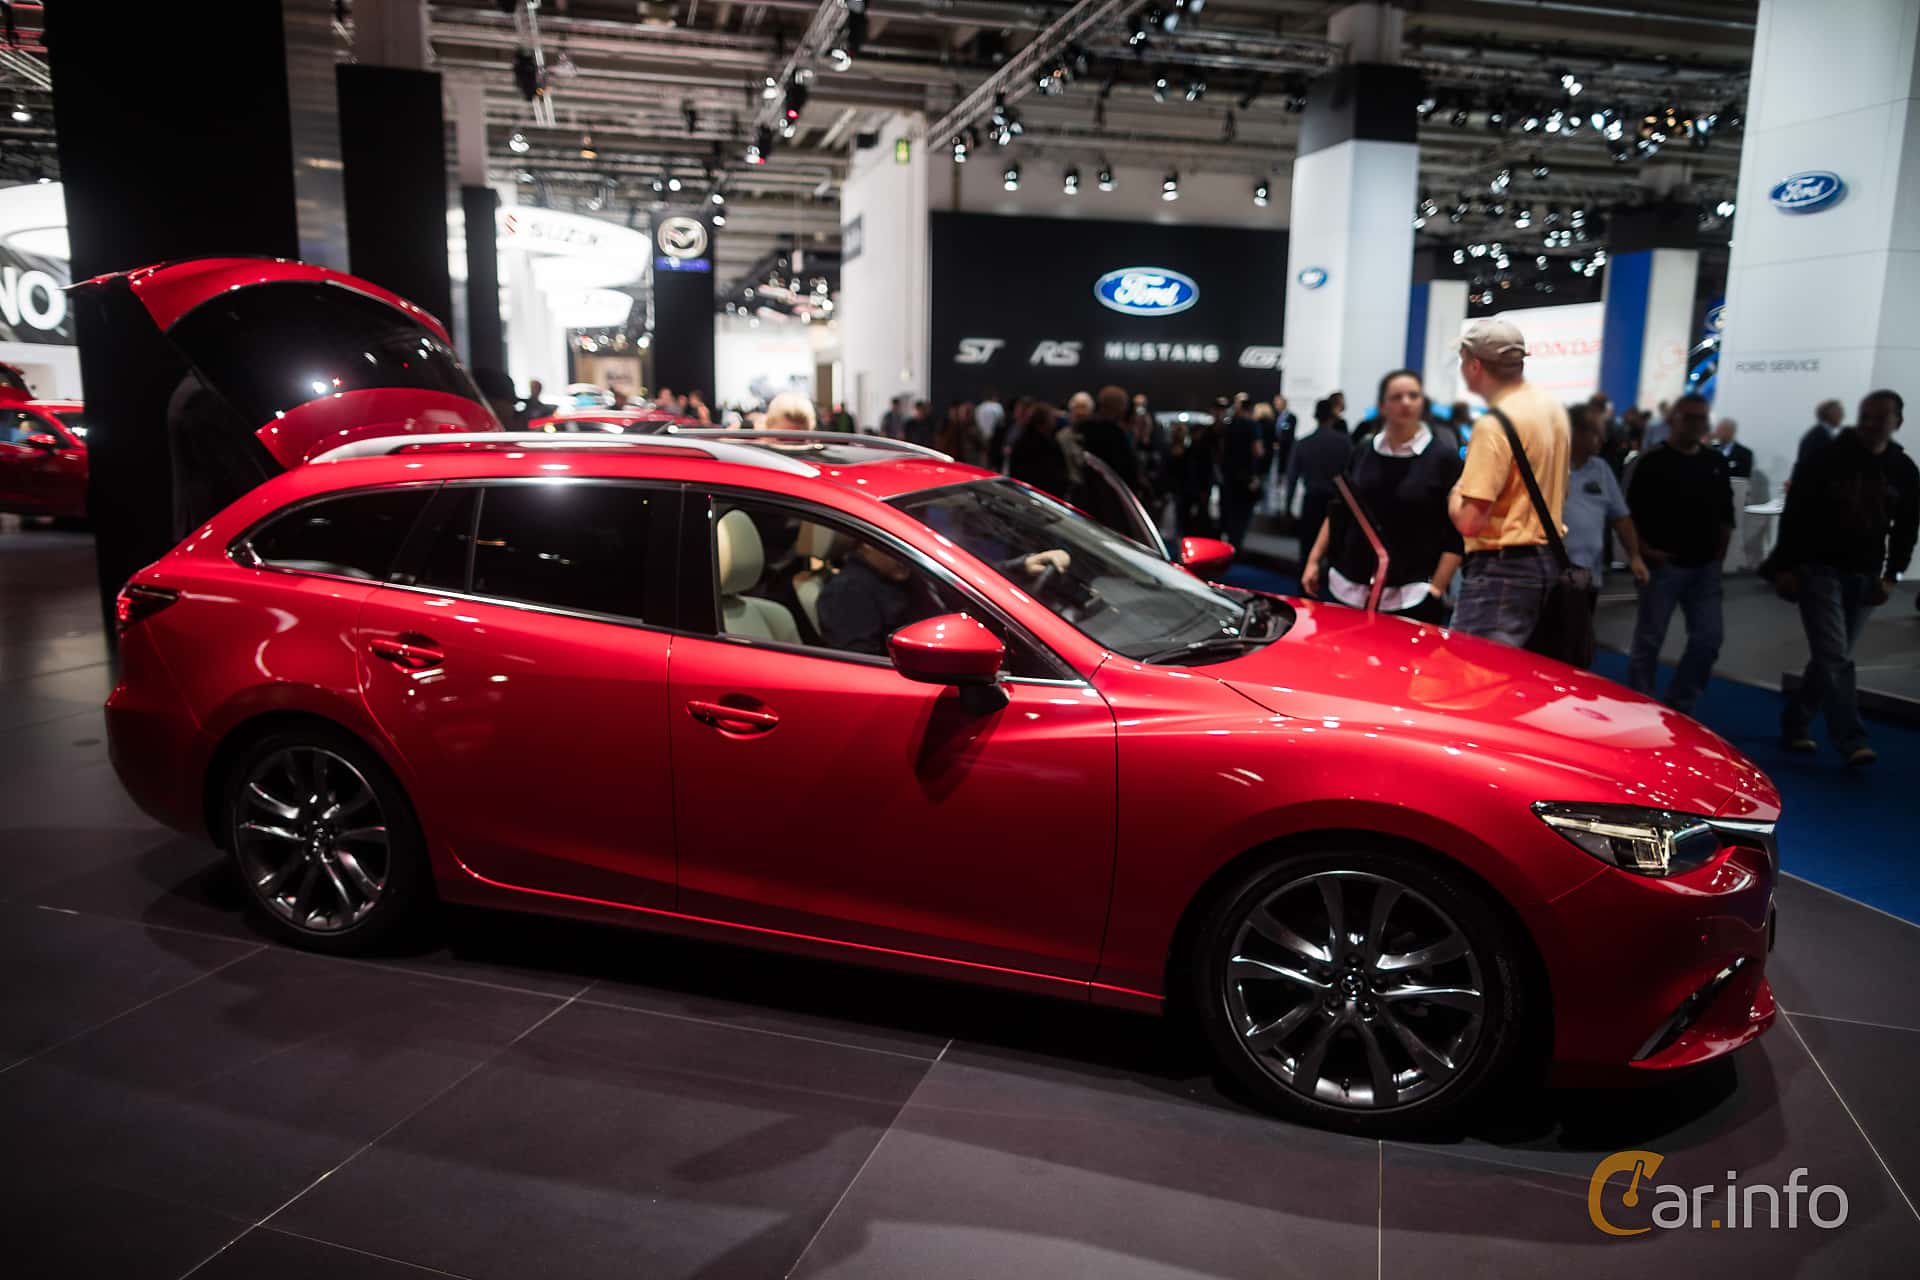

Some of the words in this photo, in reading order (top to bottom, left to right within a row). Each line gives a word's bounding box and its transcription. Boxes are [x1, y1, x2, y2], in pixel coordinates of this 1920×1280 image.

[1780, 177, 1825, 201] Ford
[1114, 272, 1180, 305] Ford
[954, 338, 1005, 364] ST
[1029, 340, 1082, 366] RS
[1104, 342, 1220, 363] MUSTANG
[1769, 358, 1820, 373] SERVICE
